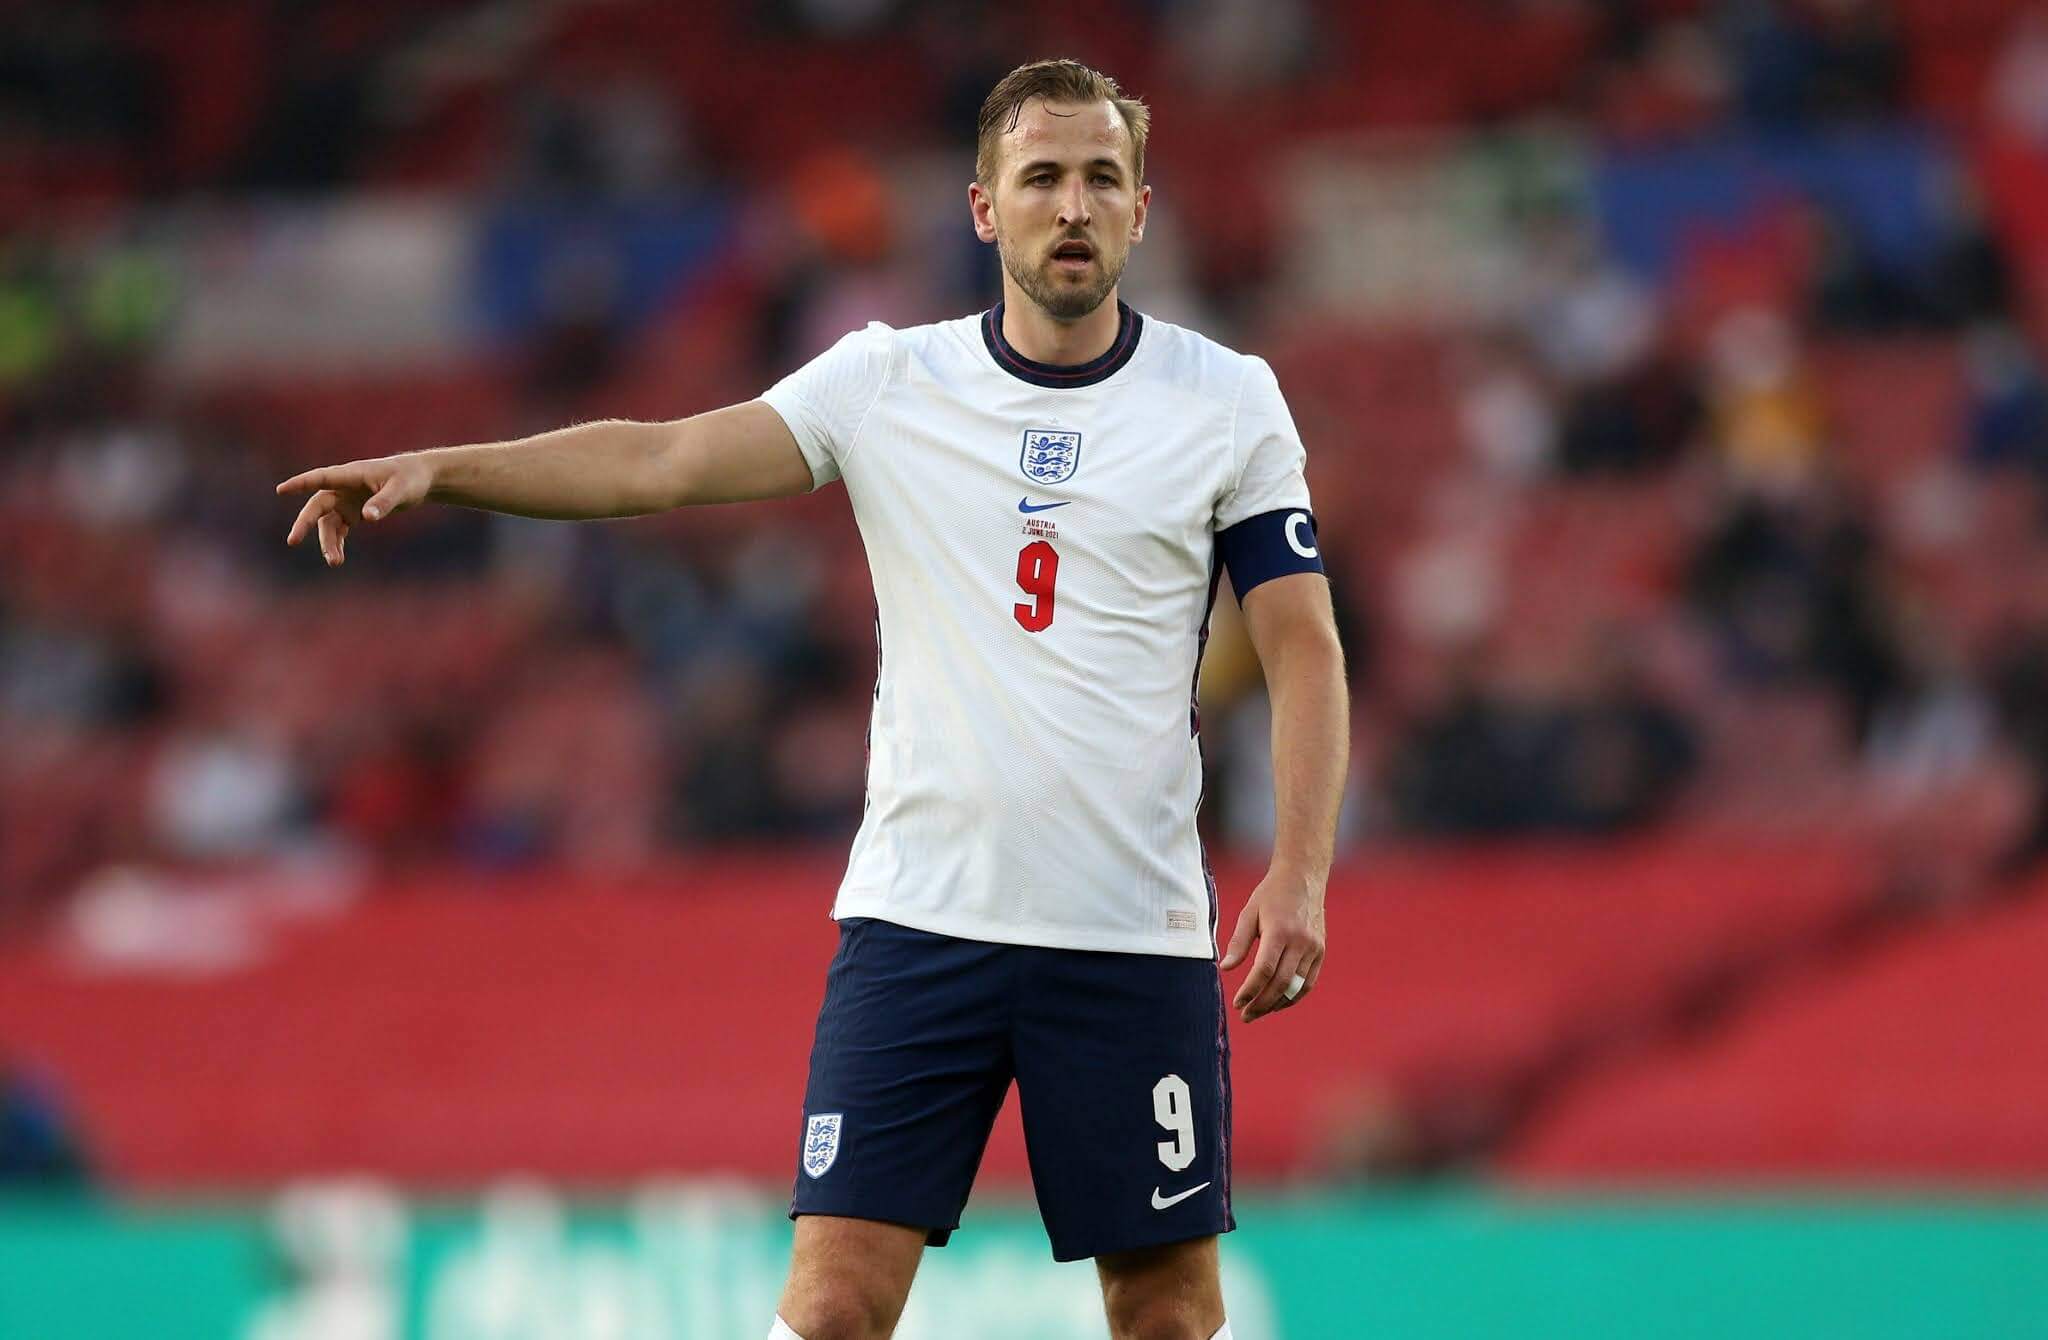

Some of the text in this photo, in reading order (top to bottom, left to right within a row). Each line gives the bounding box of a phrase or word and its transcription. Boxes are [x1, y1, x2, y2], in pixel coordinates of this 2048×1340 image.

[1026, 519, 1056, 530] AUSTRIA
[1027, 528, 1043, 537] JUNE
[1045, 530, 1058, 538] 2021
[1285, 512, 1318, 559] C
[1014, 541, 1060, 633] 9
[1152, 1073, 1196, 1172] 9
